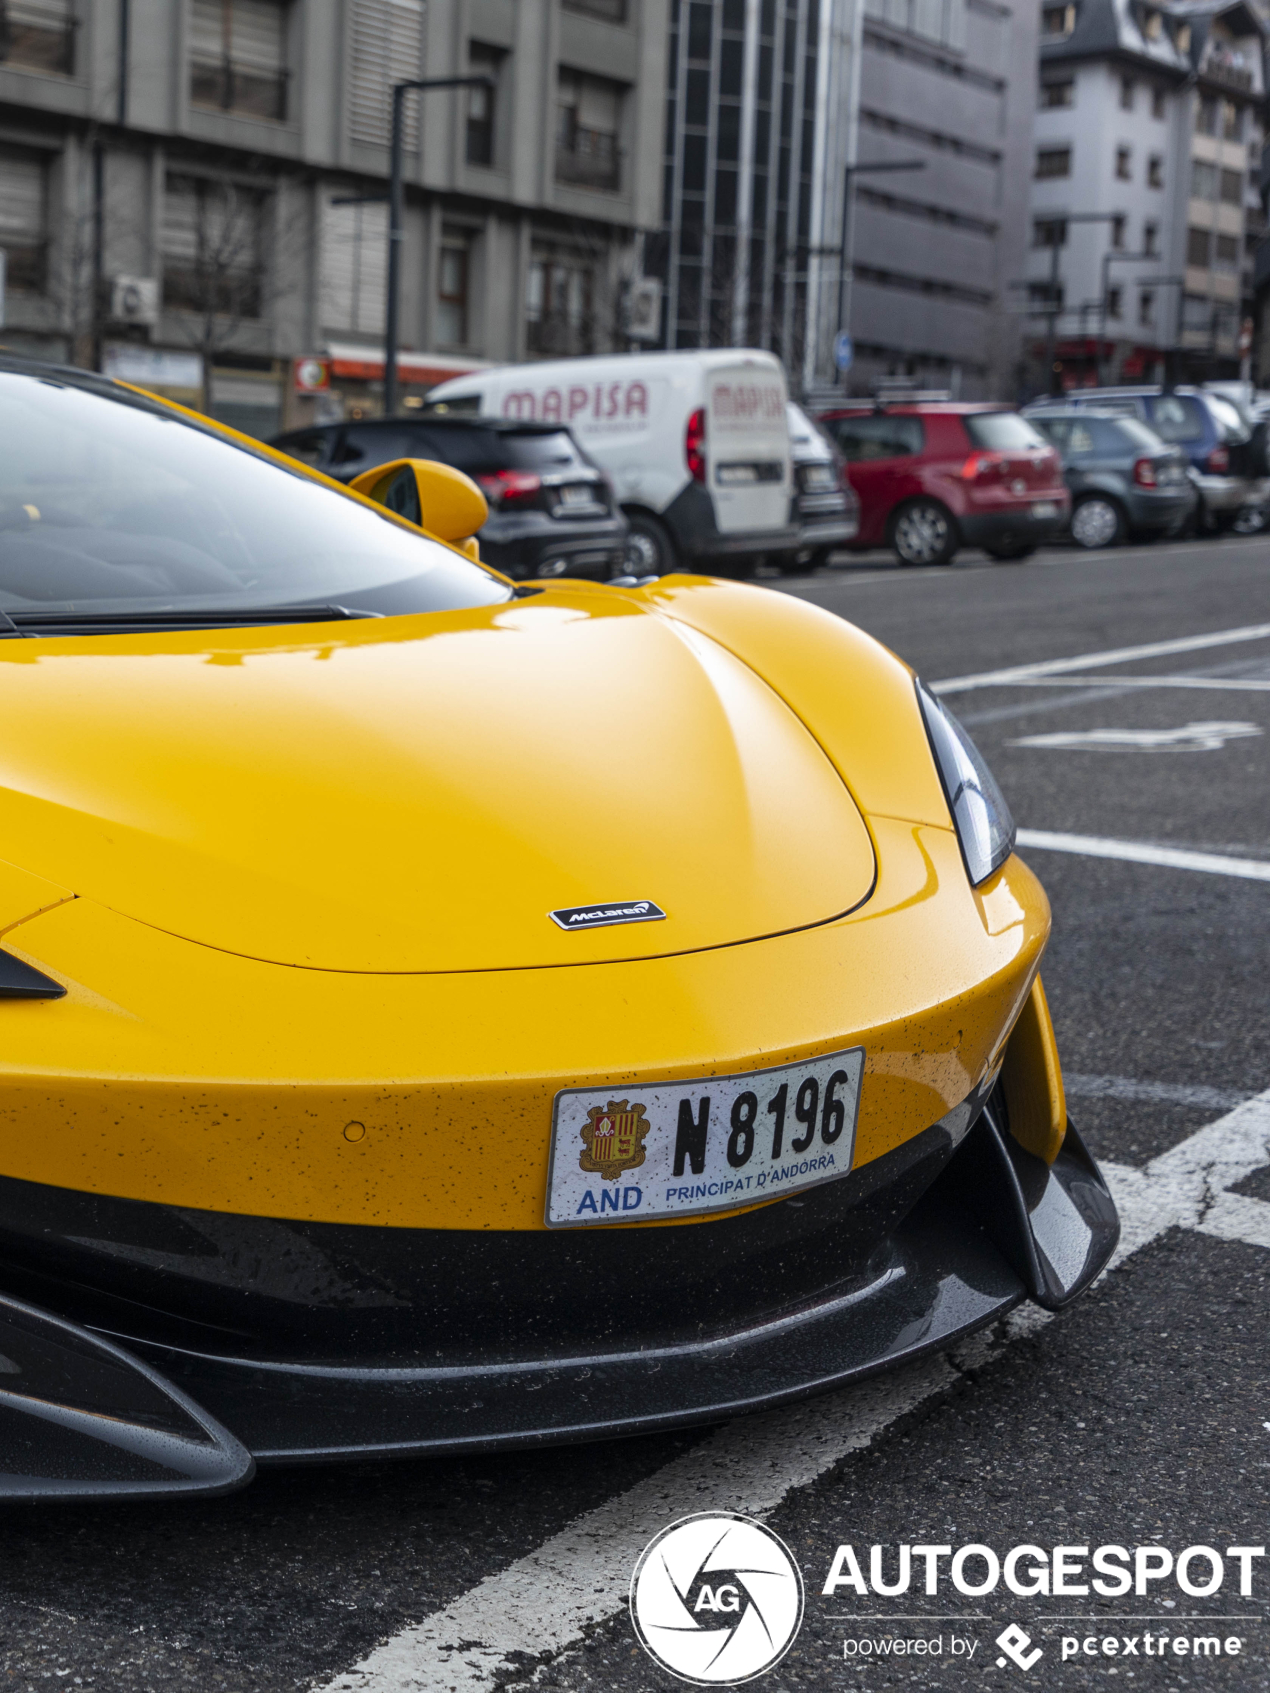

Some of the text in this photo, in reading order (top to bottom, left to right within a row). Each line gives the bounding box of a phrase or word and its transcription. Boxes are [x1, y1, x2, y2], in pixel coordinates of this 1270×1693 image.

[502, 379, 648, 424] MAPISA
[569, 904, 648, 923] McLaren
[673, 1069, 848, 1177] N 8196
[666, 1153, 835, 1201] PRINCIPAT D'ANDORRA
[576, 1186, 642, 1215] AND
